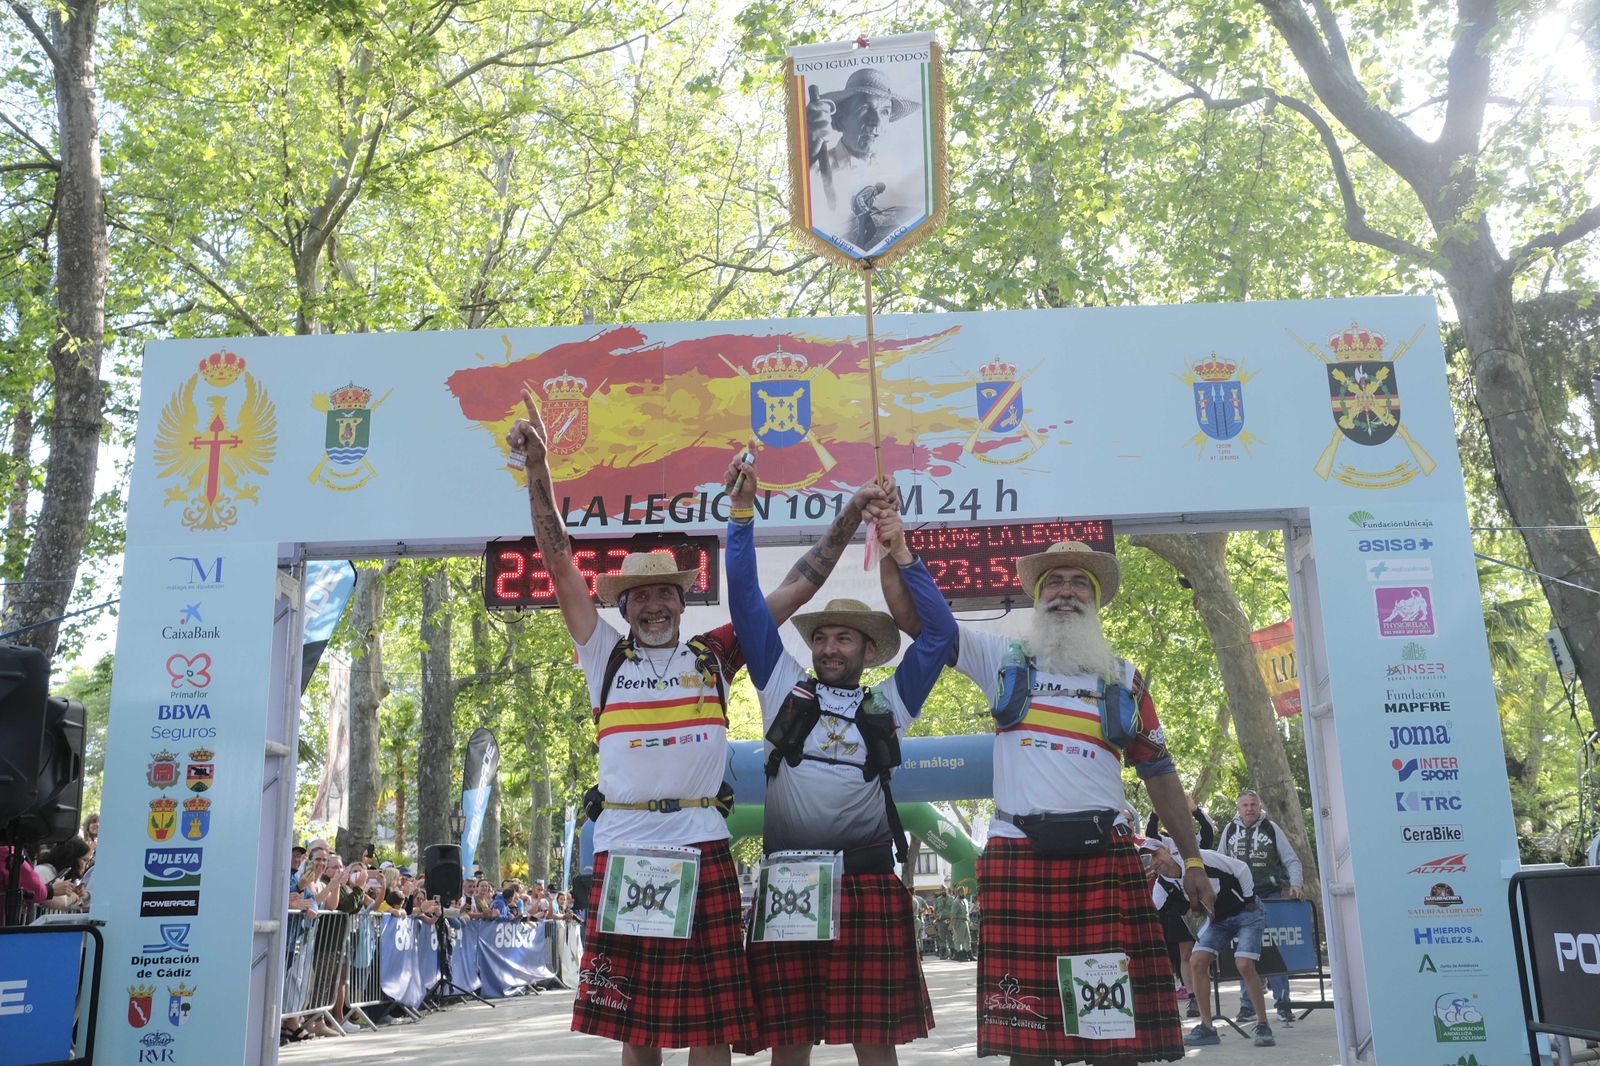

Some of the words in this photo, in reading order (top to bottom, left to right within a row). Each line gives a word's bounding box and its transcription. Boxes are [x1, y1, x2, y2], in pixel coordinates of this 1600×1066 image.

[796, 61, 822, 73] UNO
[825, 57, 859, 71] IGUAL
[861, 55, 886, 66] QUE
[886, 51, 929, 63] TODOS
[828, 234, 853, 254] SUPER
[562, 495, 609, 528] LA
[937, 487, 982, 521] 24
[995, 479, 1018, 512] h
[988, 526, 1014, 546] LA
[1358, 538, 1417, 553] asisa
[162, 626, 221, 640] CaixaBank
[170, 690, 208, 700] Primaflor
[1386, 689, 1446, 701] Fundación
[158, 704, 211, 720] BBVA
[1384, 701, 1451, 713] MAPFRE
[150, 726, 217, 742] Seguros
[904, 758, 917, 770] de
[919, 757, 966, 772] málaga
[1419, 757, 1459, 769] INTER
[1420, 769, 1460, 781] SPORT
[1420, 796, 1463, 811] TRC
[1402, 826, 1462, 842] CeraBike
[148, 852, 200, 865] PULEVA
[1407, 865, 1467, 875] ALTRA
[142, 900, 196, 908] POWERADE
[626, 883, 673, 911] 907
[771, 889, 812, 915] 893
[1433, 926, 1473, 935] HIERROS
[131, 954, 200, 967] Diputación
[1555, 932, 1600, 975] PO
[137, 969, 153, 978] de
[156, 968, 192, 978] Cádiz
[1081, 983, 1126, 1011] 920
